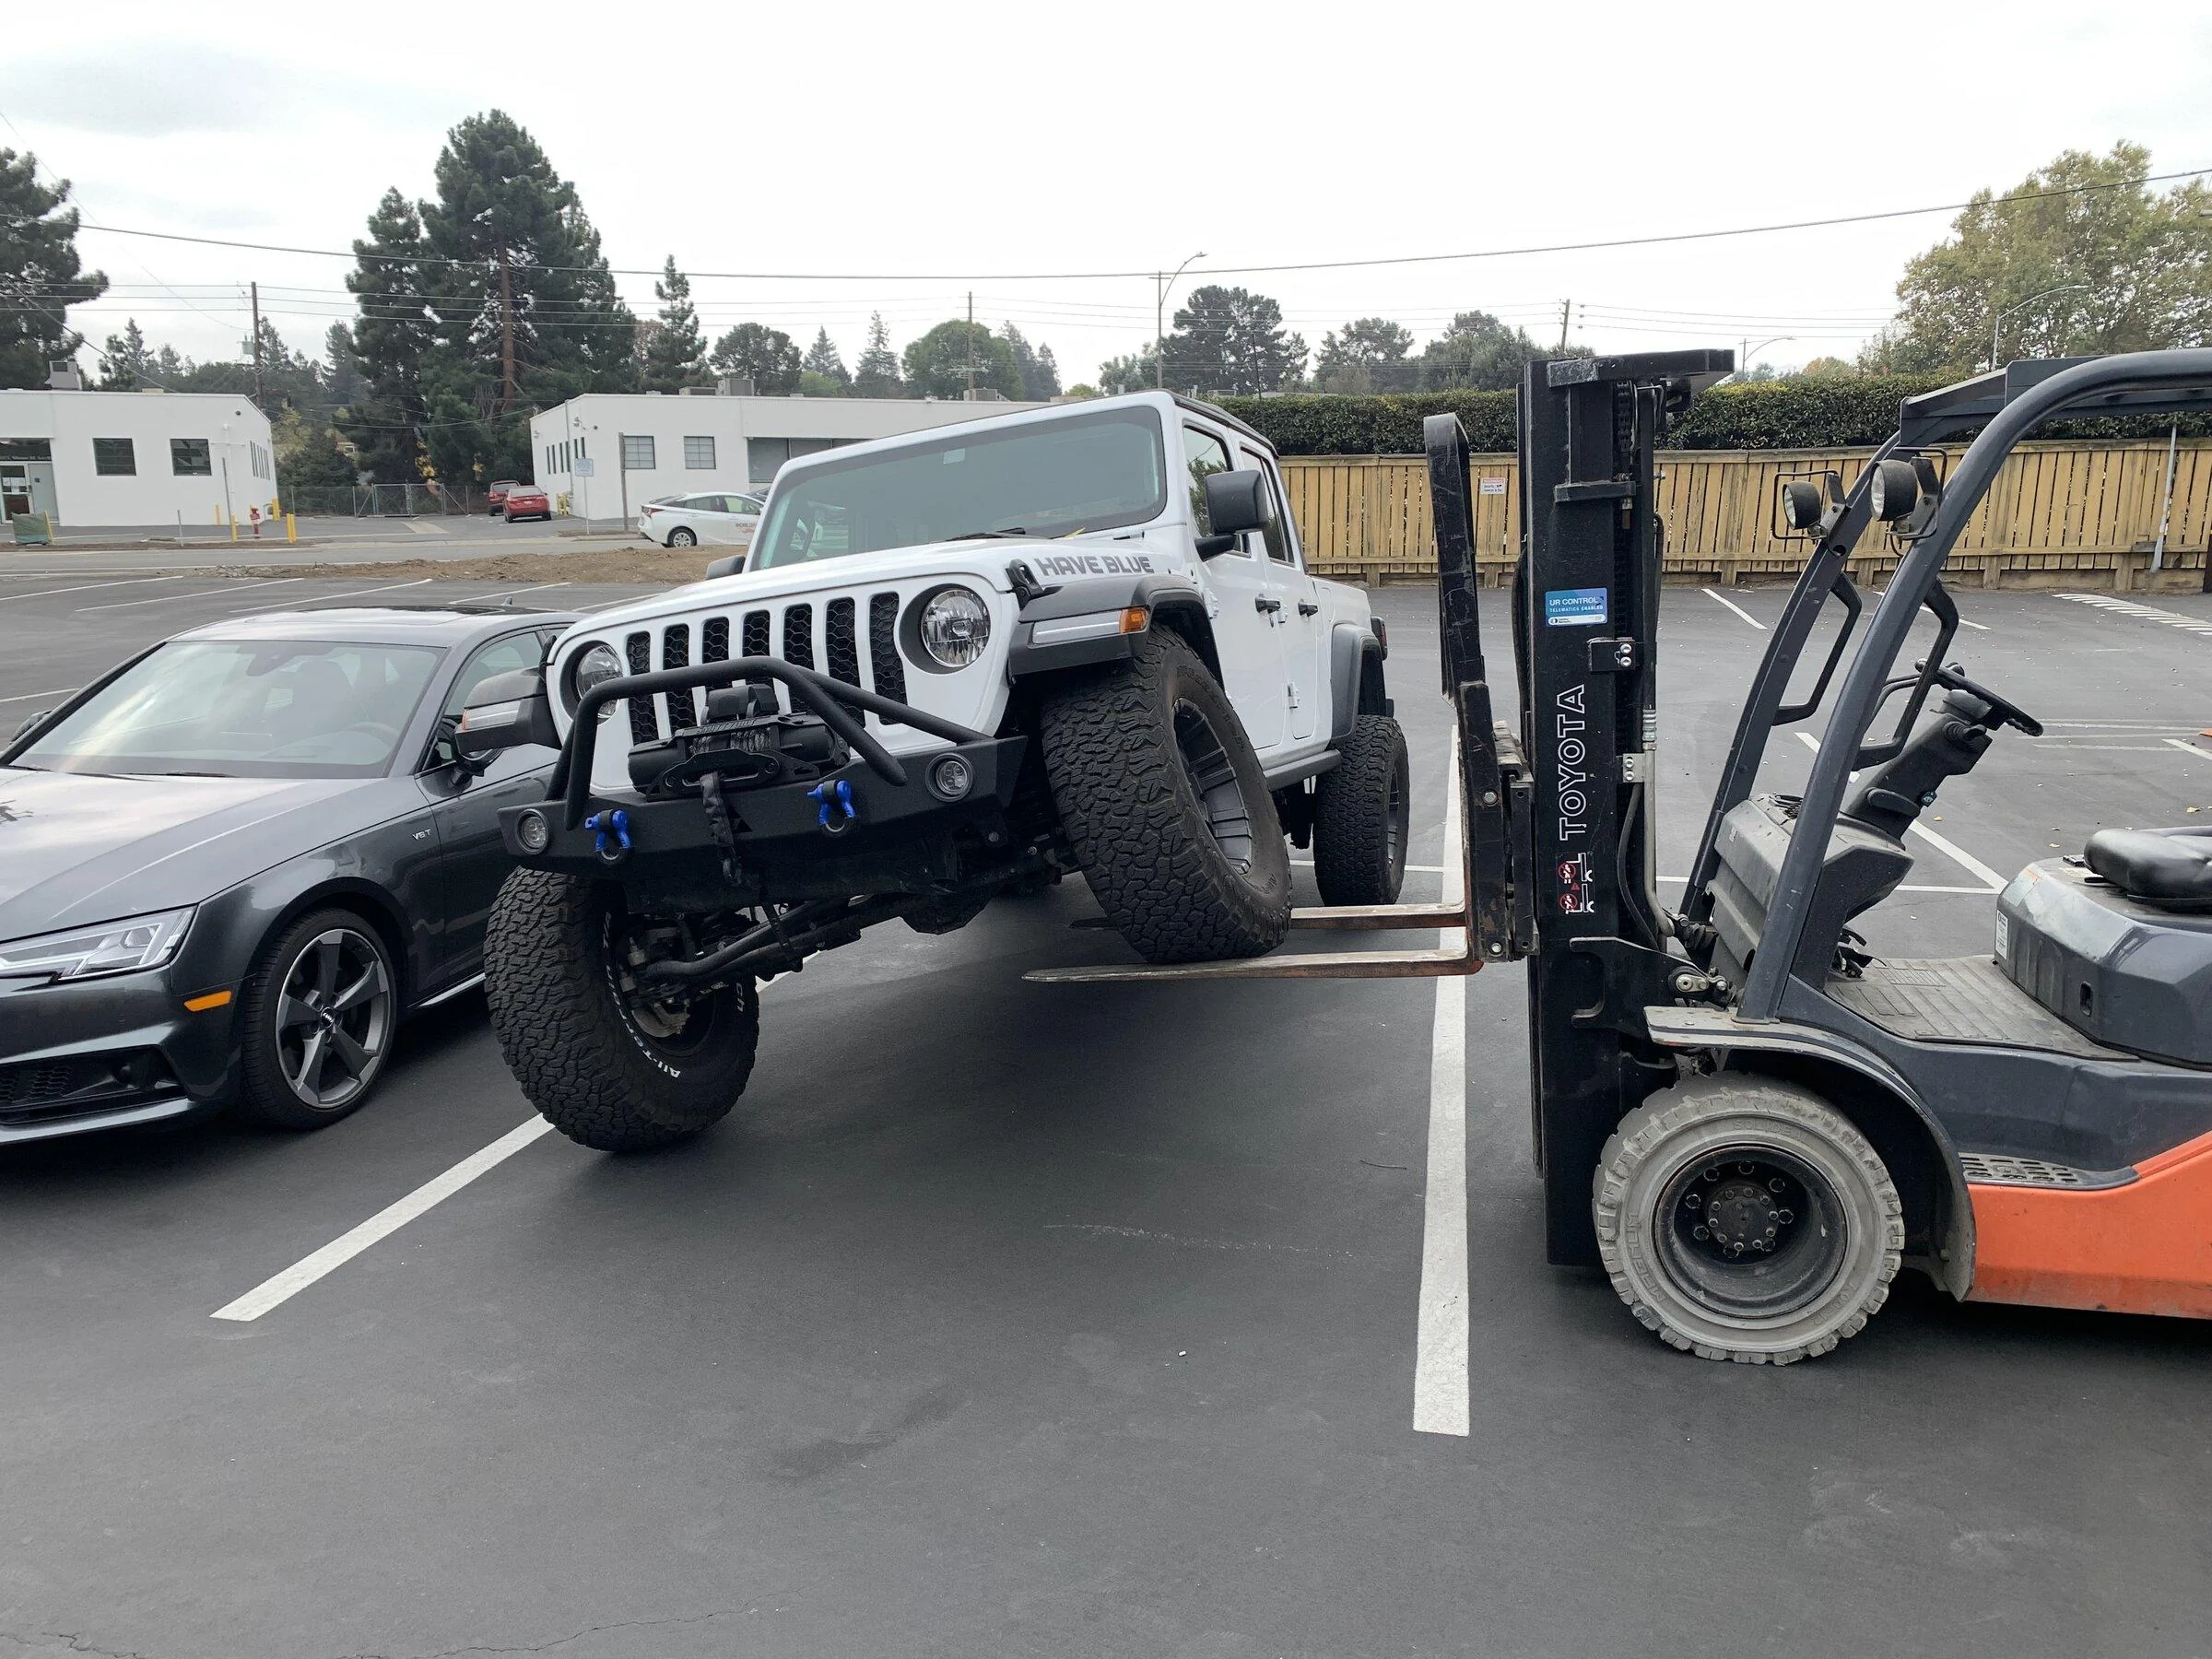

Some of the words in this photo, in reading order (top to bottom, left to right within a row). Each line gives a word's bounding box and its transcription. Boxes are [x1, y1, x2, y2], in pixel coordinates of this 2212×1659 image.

[1034, 556, 1104, 576] HAVE
[1100, 556, 1155, 573] BLUE
[1562, 597, 1598, 606] CONTROL
[1557, 684, 1586, 841] TOYOTA
